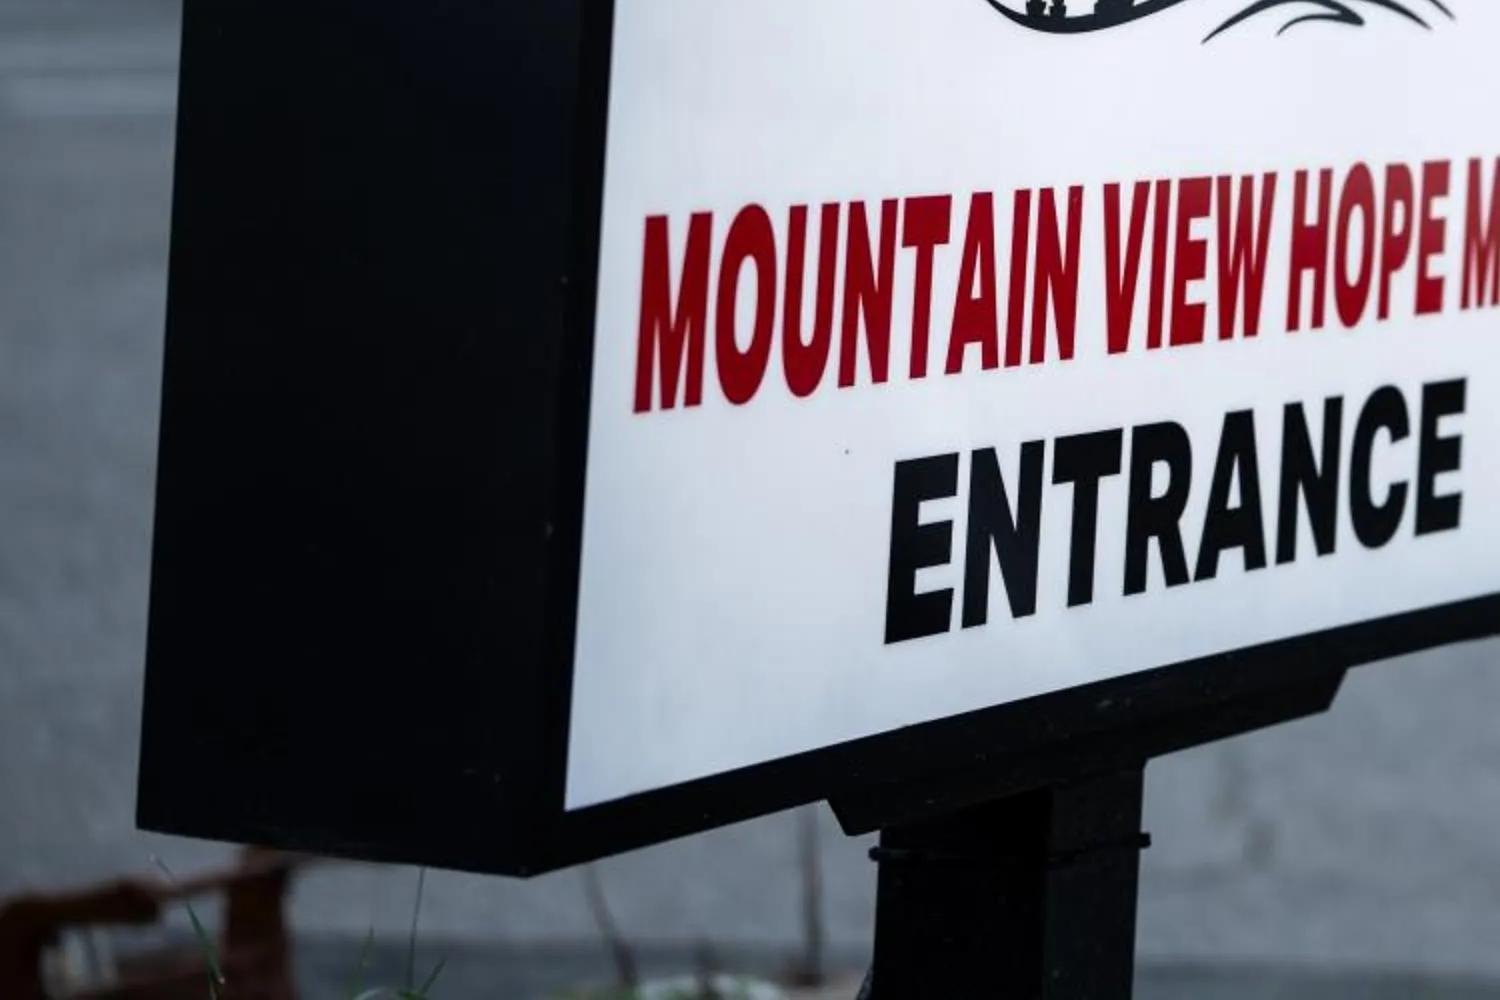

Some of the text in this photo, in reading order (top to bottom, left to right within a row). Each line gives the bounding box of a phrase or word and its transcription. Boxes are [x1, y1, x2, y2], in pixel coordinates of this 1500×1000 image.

[634, 183, 1084, 413] MOUNTAIN
[1102, 172, 1277, 355] VIEW
[1284, 159, 1451, 331] HOPE
[884, 377, 1467, 645] ENTRANCE
